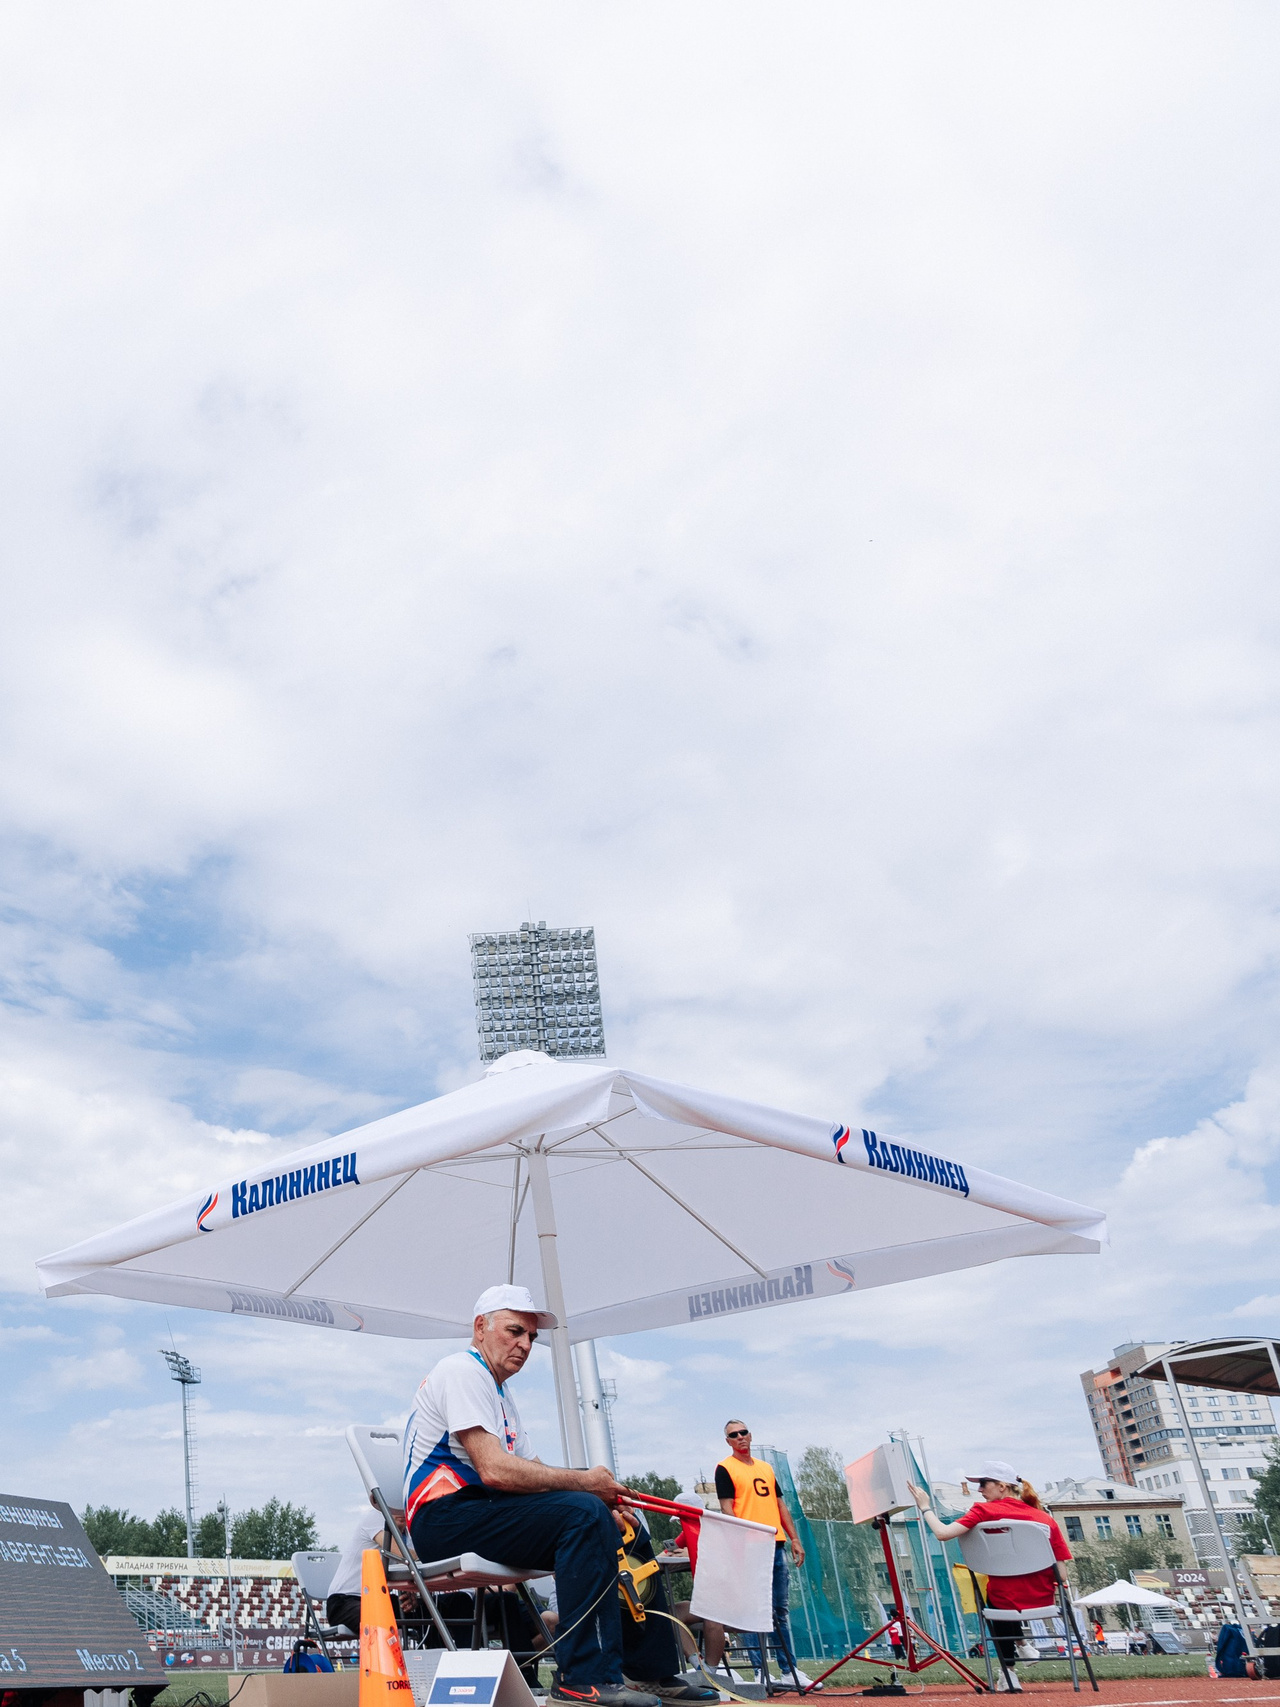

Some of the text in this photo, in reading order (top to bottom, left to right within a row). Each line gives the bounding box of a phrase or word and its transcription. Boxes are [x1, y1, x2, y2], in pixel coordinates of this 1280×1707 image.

[753, 1478, 770, 1497] G
[115, 1561, 188, 1571] ЗАПАДНАЯ ТРИБУНА
[1176, 1573, 1207, 1583] 2024
[10, 1648, 27, 1672] 5
[76, 1649, 144, 1671] Место 2
